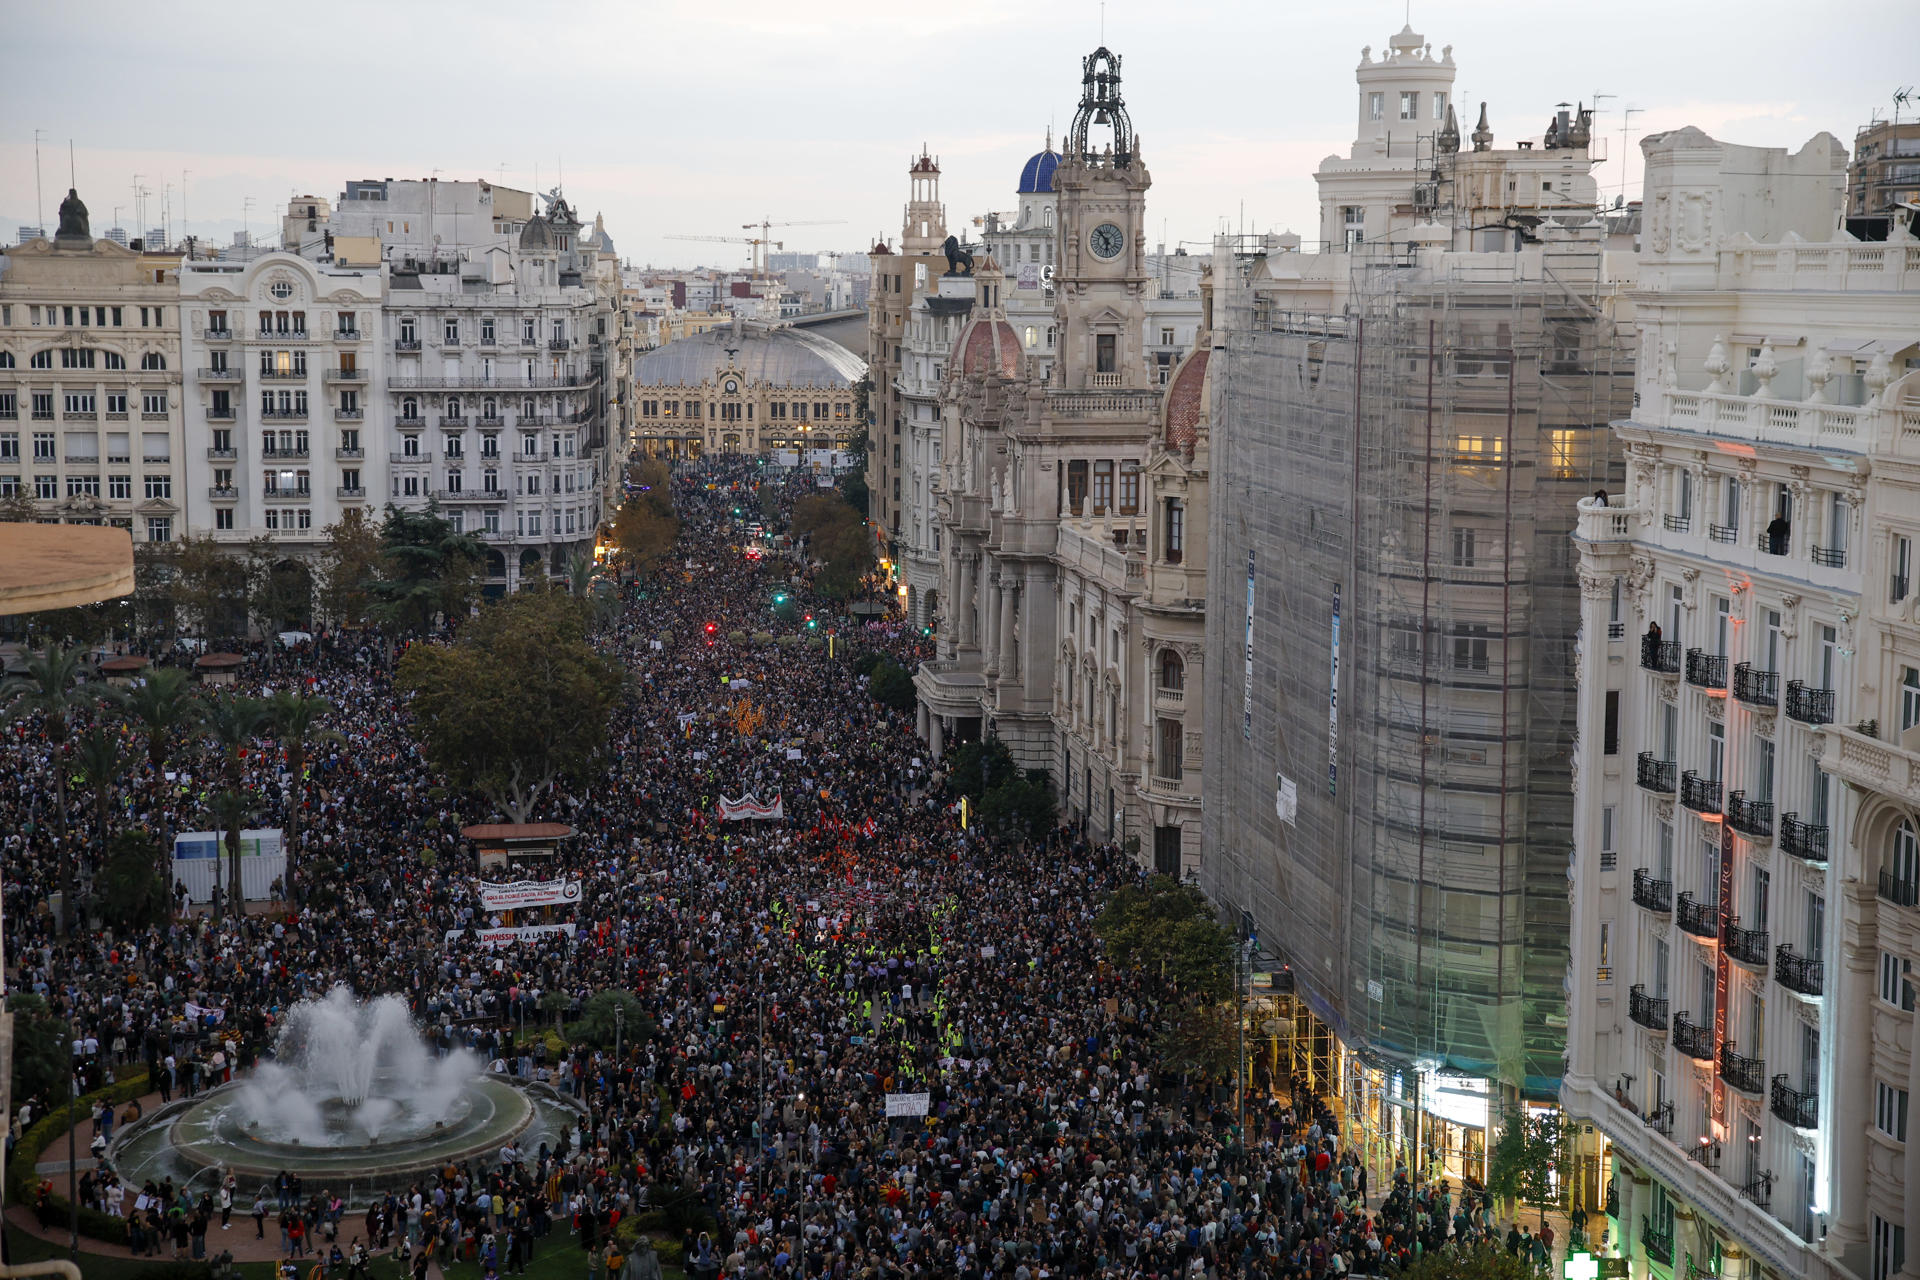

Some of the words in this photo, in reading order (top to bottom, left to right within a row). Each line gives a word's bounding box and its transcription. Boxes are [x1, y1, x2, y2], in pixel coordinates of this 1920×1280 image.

[1041, 265, 1057, 282] G
[1715, 1007, 1725, 1076] VENECIA
[1720, 862, 1732, 928] CENTRO
